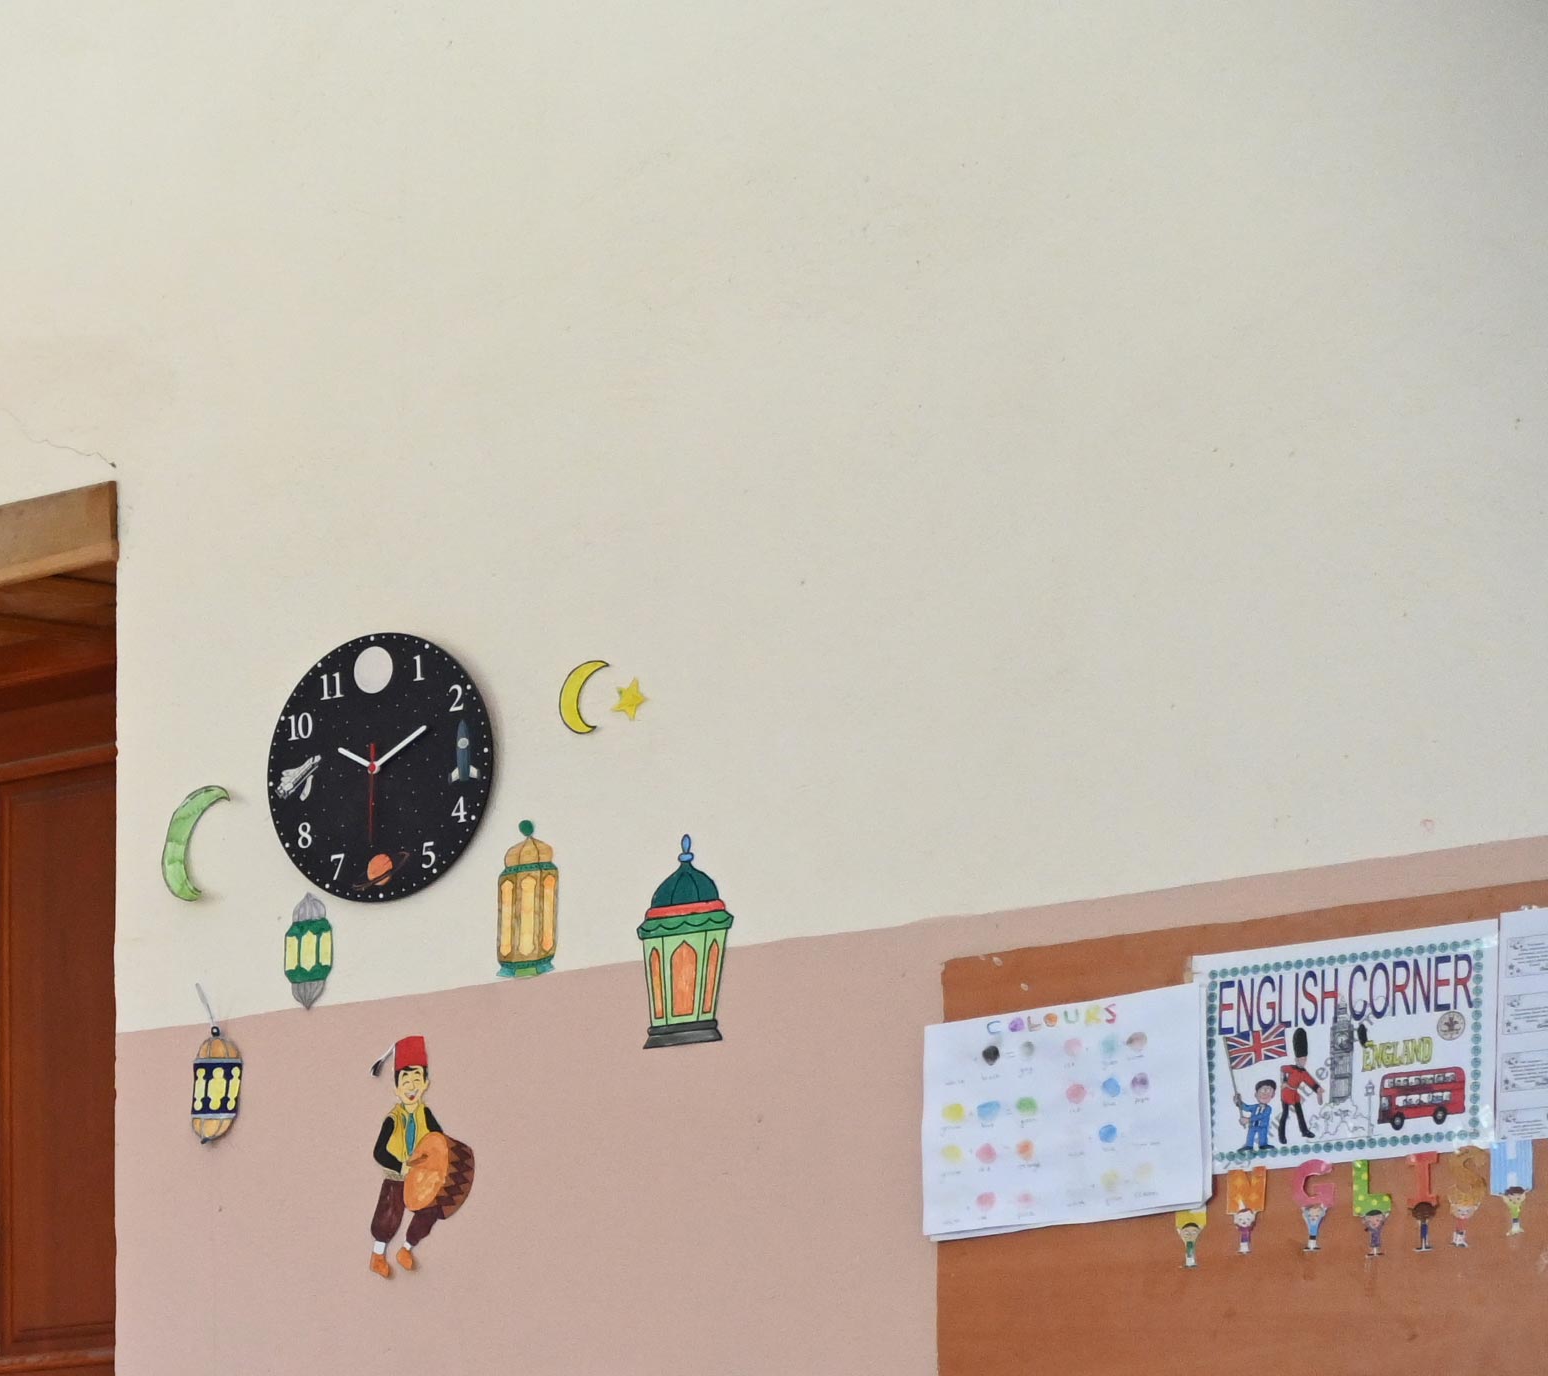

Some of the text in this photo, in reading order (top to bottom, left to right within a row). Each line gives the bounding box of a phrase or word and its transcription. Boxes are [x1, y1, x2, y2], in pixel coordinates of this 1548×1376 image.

[412, 655, 425, 681] 1
[319, 672, 345, 700] 11
[448, 684, 464, 712] 2
[287, 712, 313, 741] 10
[451, 796, 467, 823] 4
[297, 822, 312, 849] 8
[330, 853, 345, 880] 7
[421, 841, 436, 869] 5
[1218, 968, 1338, 1035] ENGLISH
[1349, 954, 1473, 1021] CORNER
[987, 1003, 1117, 1034] COLOURS
[1361, 1036, 1433, 1072] ENGLAND
[1175, 1139, 1533, 1226] NGLISH
